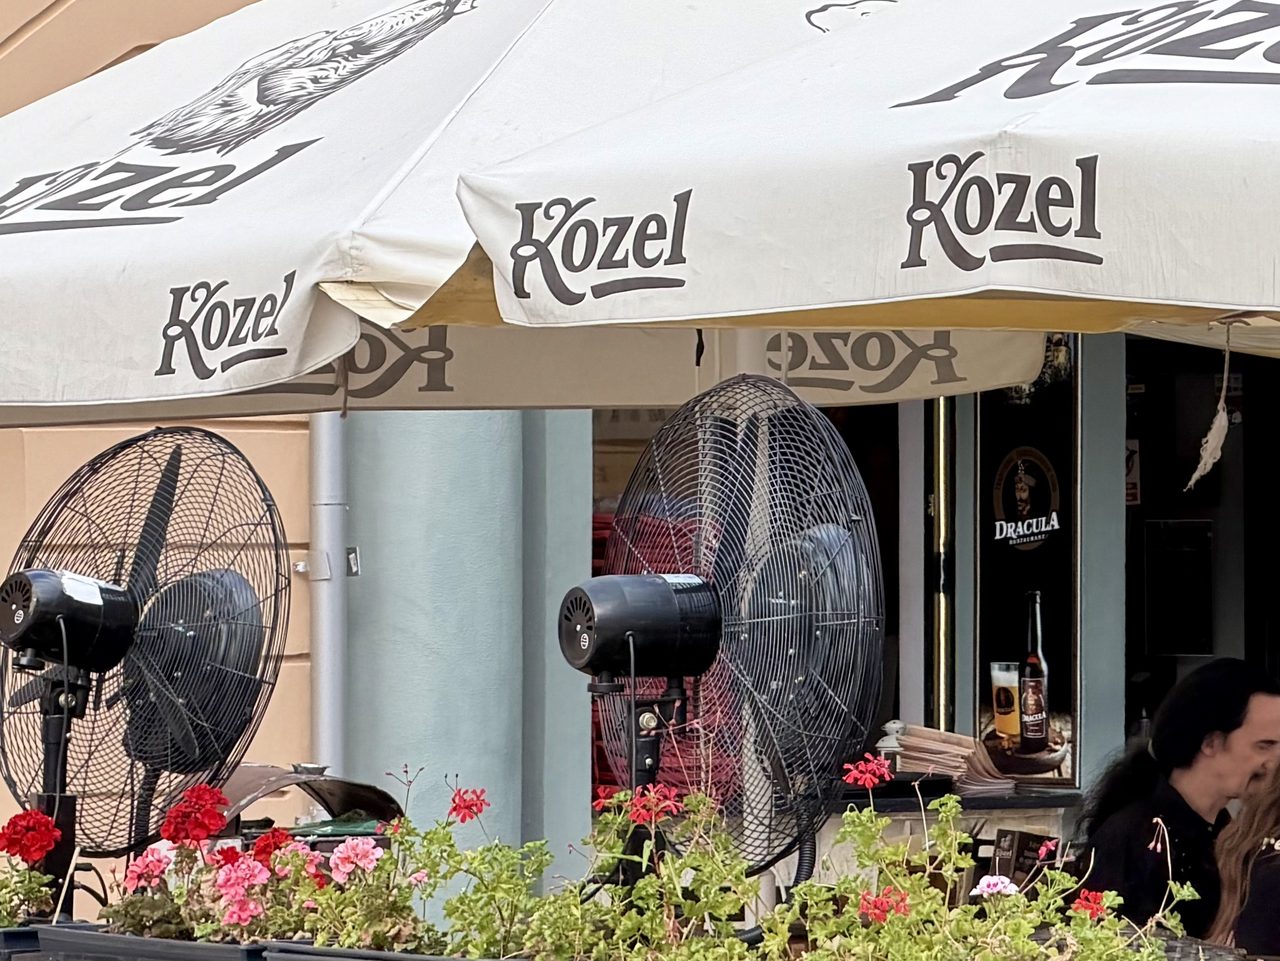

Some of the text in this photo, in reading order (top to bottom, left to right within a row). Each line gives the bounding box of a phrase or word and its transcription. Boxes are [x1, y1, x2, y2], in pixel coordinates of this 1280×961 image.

[509, 188, 693, 306] Kozel
[901, 152, 1104, 271] Kozel
[154, 270, 297, 381] Kozel
[994, 511, 1060, 540] DRACULA
